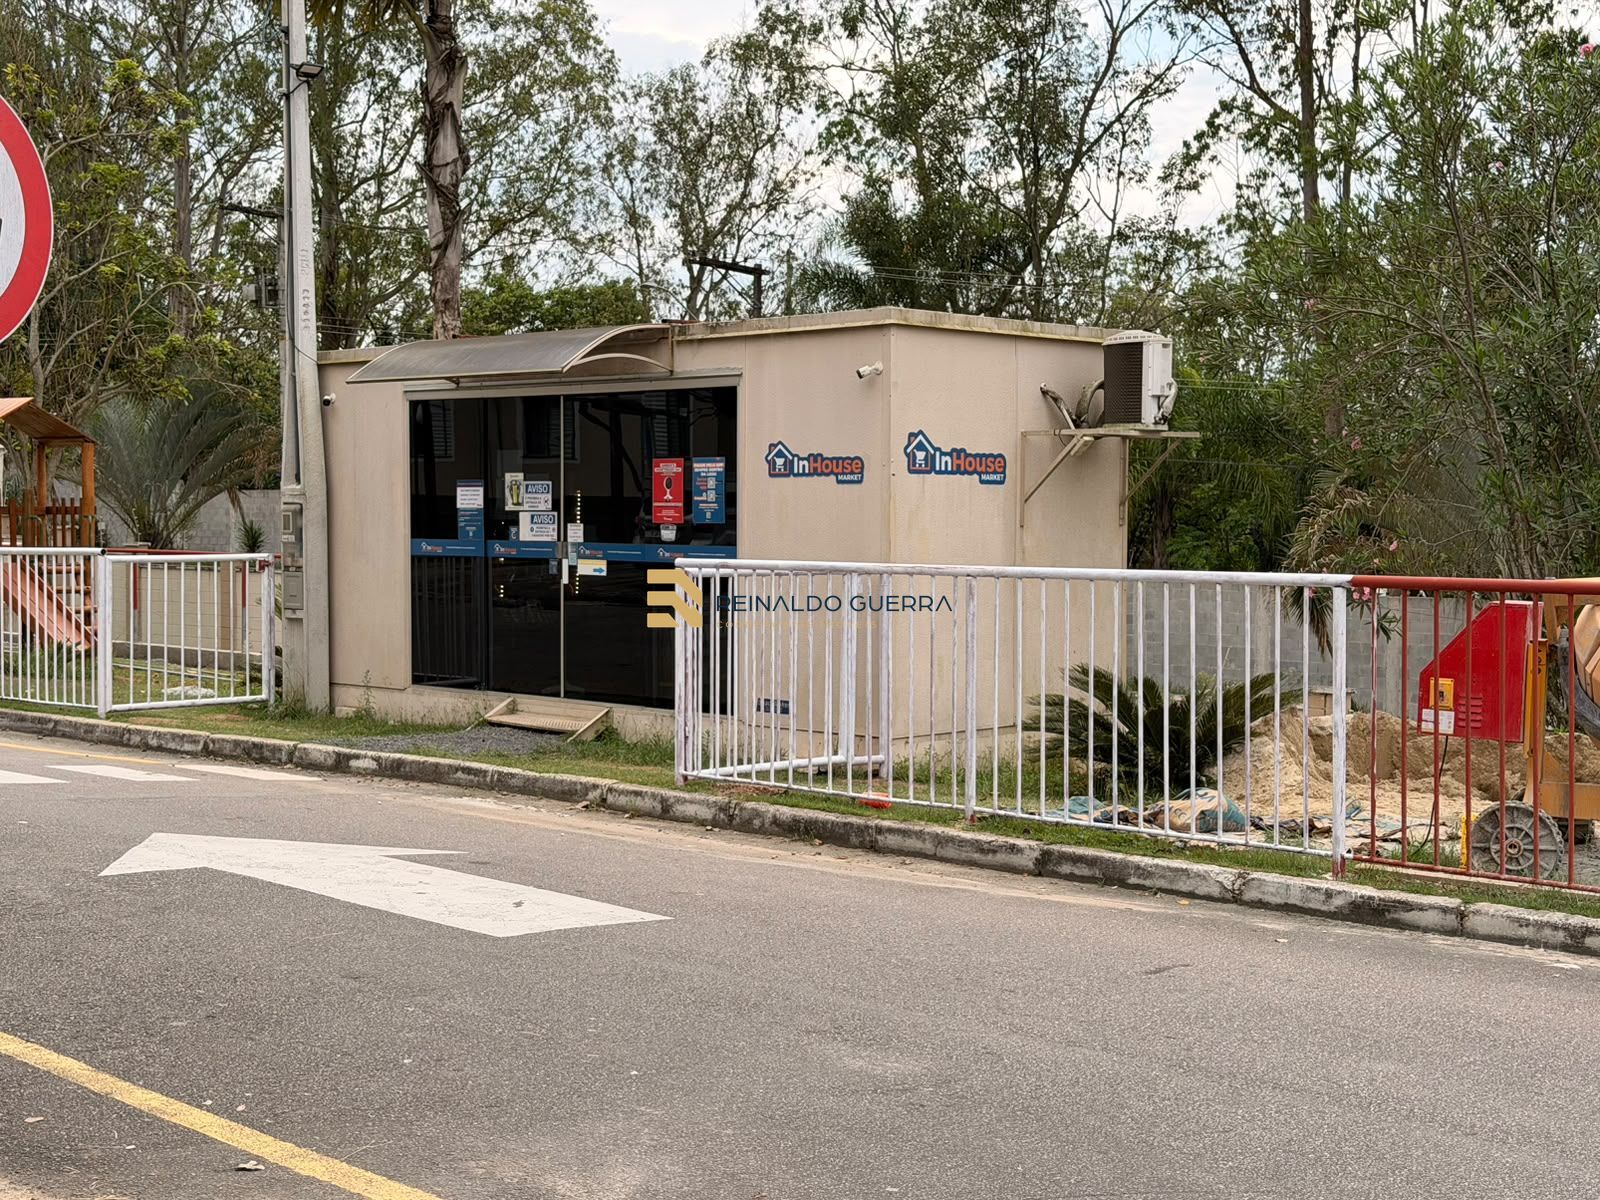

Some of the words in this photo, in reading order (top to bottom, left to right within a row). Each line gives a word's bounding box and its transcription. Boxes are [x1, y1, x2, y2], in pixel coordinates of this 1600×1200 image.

[793, 453, 862, 474] InHouse
[935, 451, 1004, 473] InHouse
[527, 484, 549, 493] AVISO
[532, 515, 554, 524] AVISO
